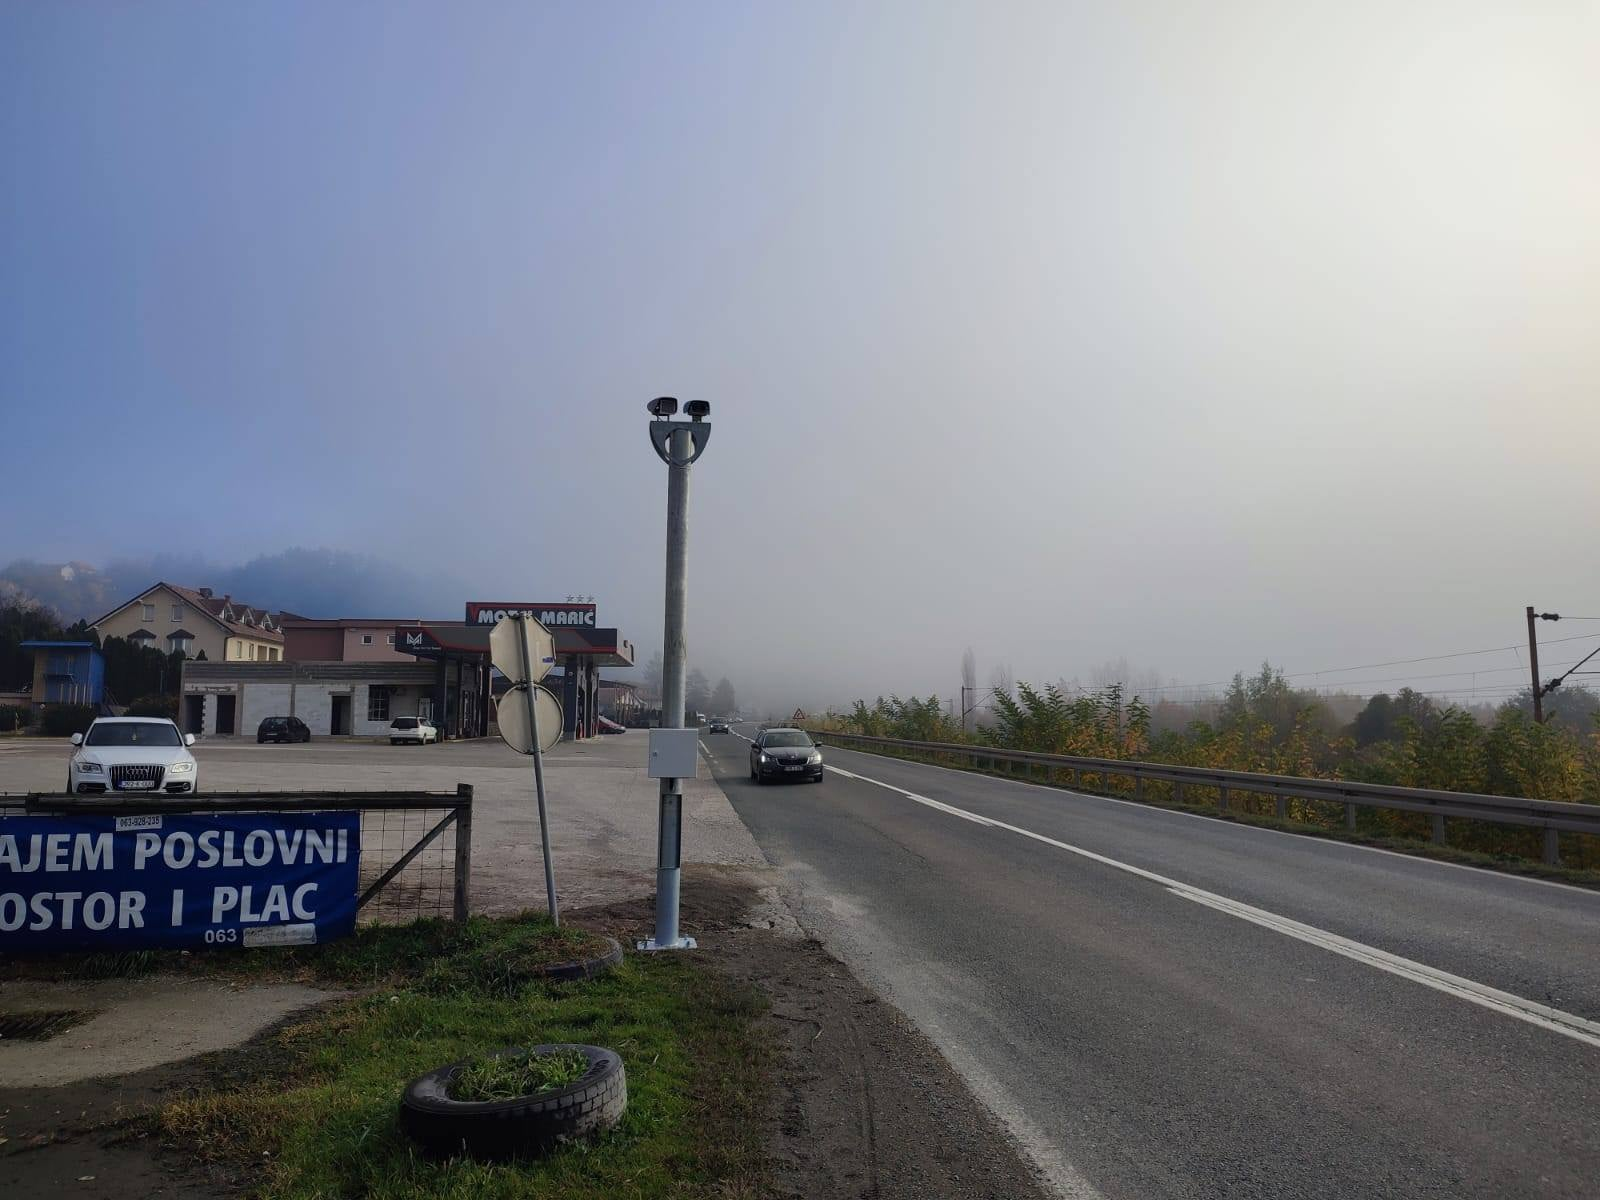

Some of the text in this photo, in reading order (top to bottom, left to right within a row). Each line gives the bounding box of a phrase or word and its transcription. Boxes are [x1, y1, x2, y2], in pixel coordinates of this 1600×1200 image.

[478, 609, 532, 624] MOT
[0, 829, 348, 873] AJEM POSLOVNI
[0, 883, 318, 931] OSTOR I PLAC
[204, 929, 238, 944] 063
